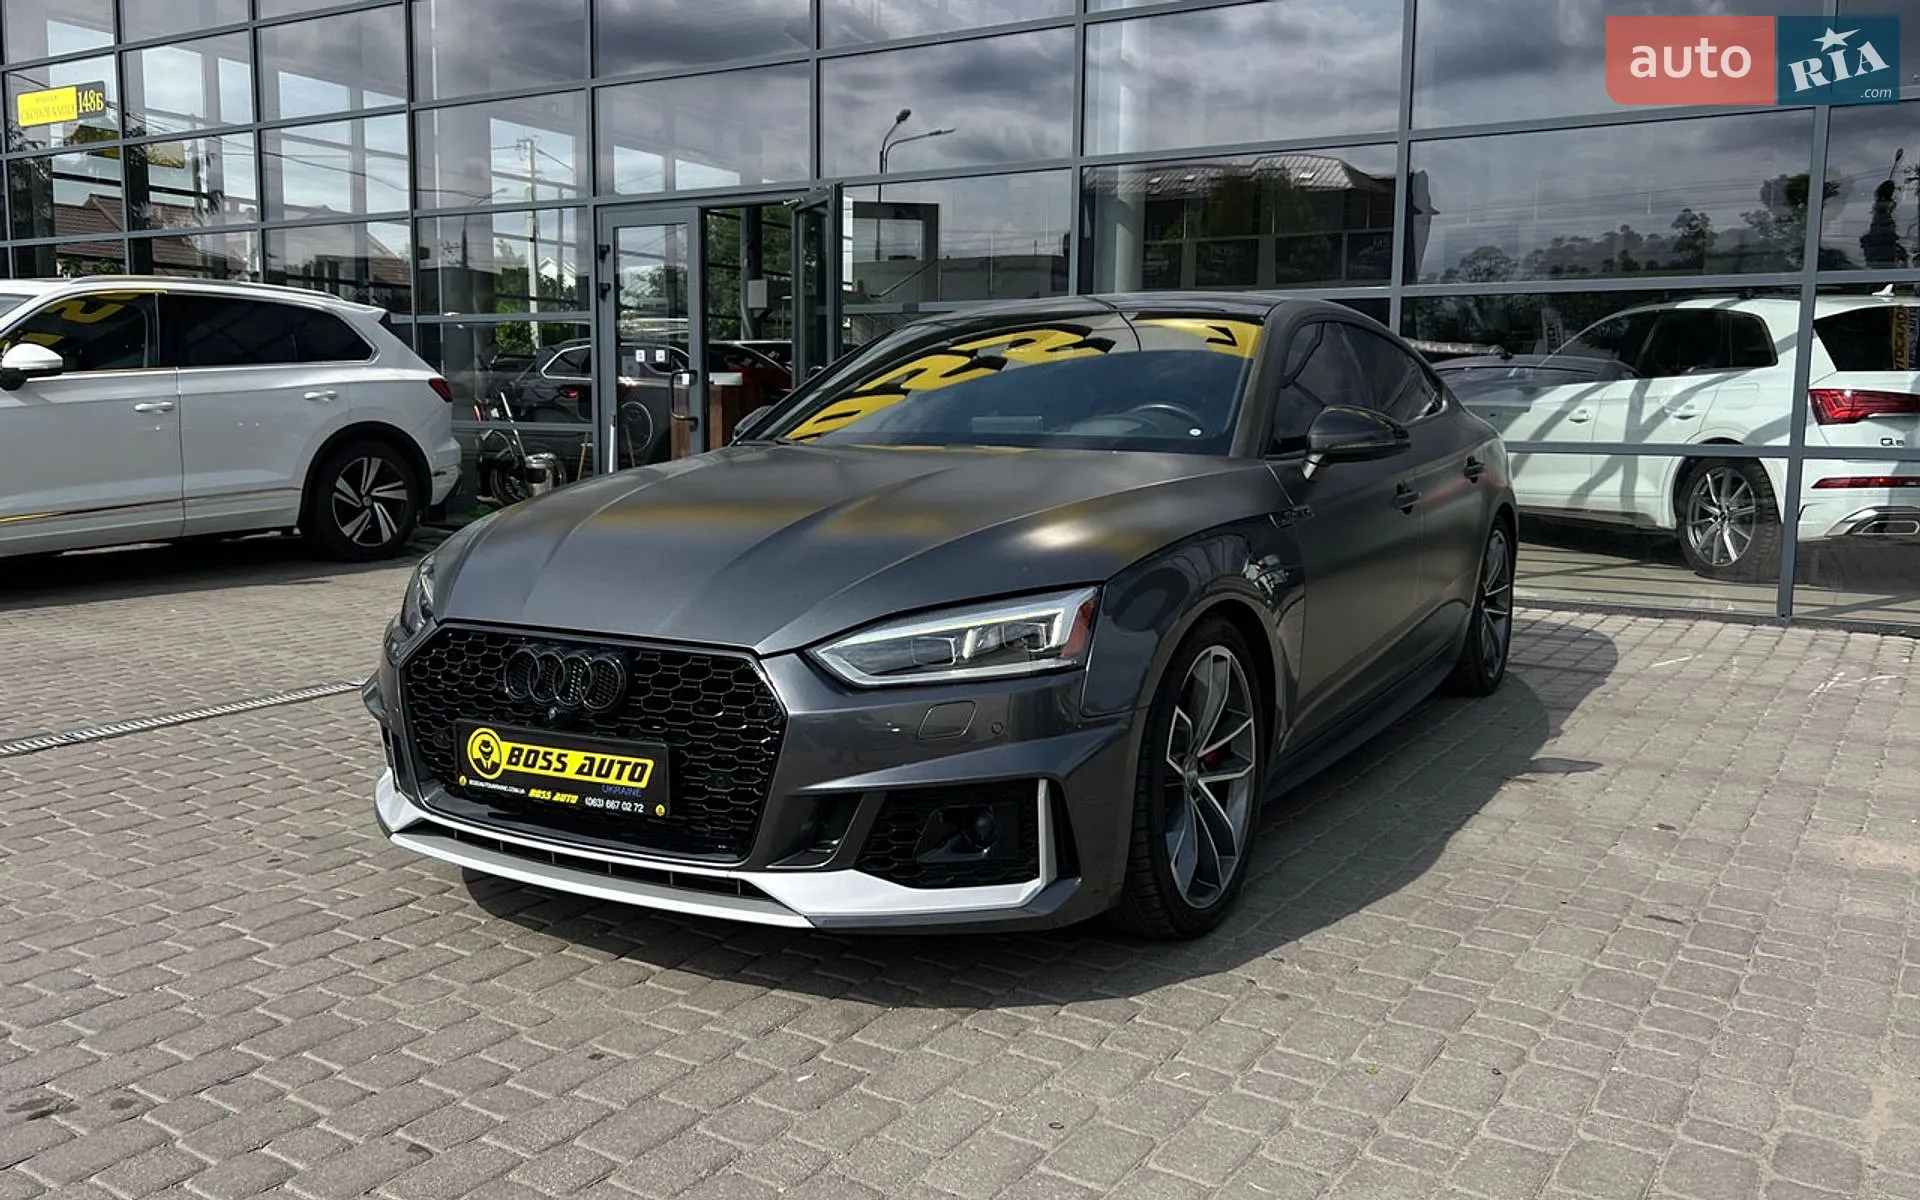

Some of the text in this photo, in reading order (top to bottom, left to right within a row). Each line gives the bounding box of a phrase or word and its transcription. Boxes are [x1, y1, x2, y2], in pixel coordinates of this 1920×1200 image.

[506, 747, 649, 783] BOSS AUTO
[528, 788, 579, 804] BOSS AUTO
[602, 785, 642, 798] UKRAINE
[633, 803, 645, 813] 72
